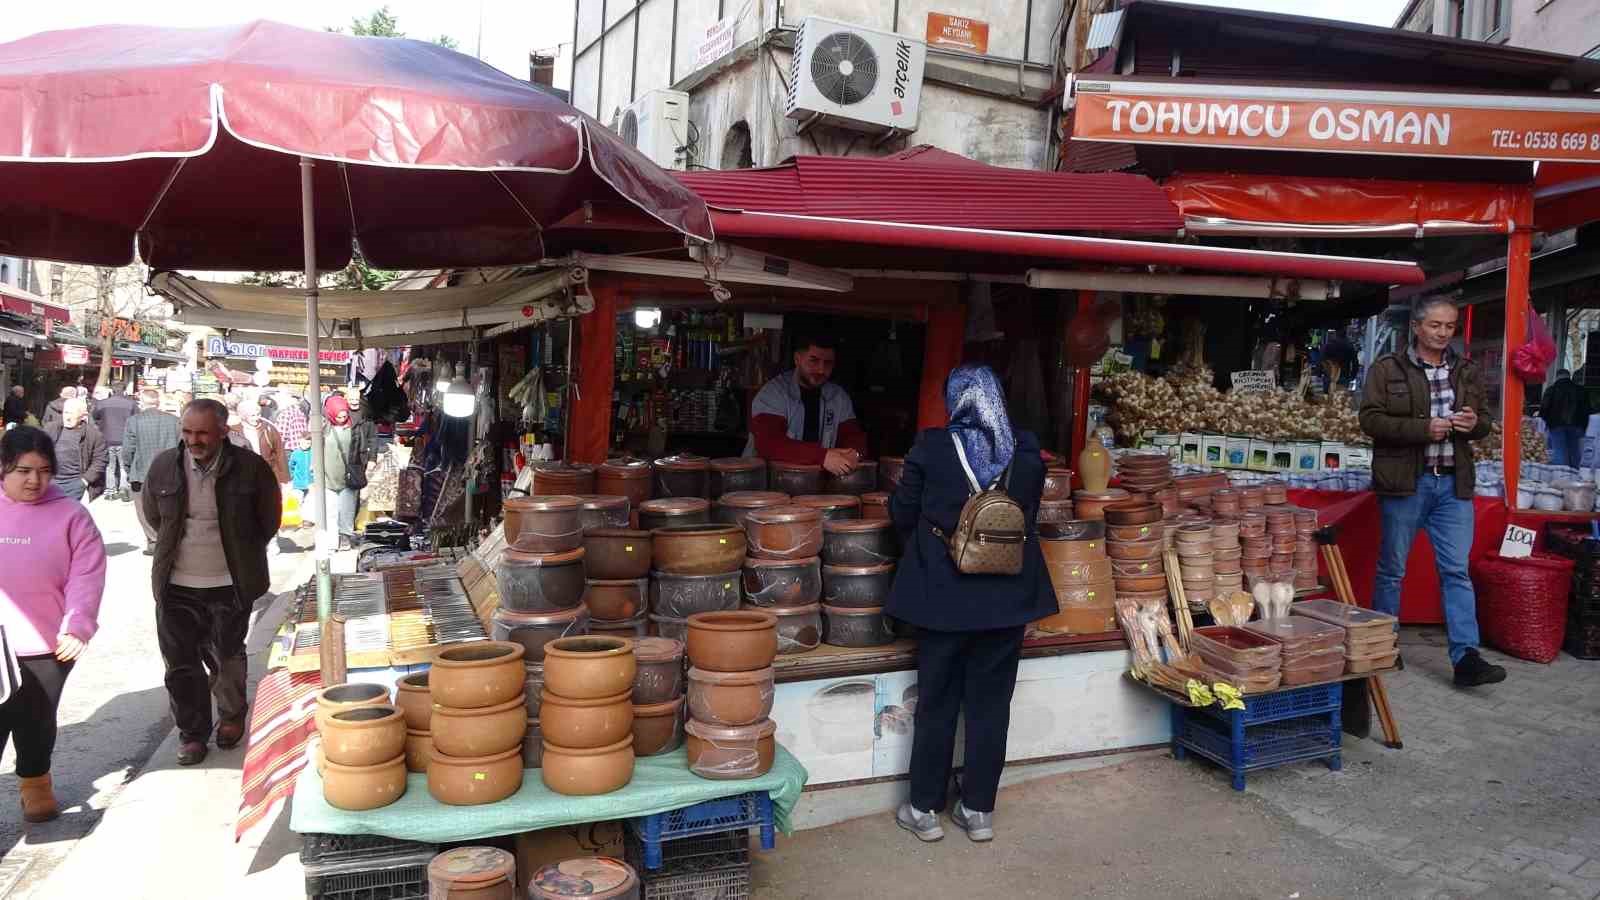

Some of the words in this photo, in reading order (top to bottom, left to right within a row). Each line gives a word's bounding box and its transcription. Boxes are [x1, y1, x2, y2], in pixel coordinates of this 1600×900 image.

[893, 40, 911, 99] arçelik
[1106, 101, 1290, 138] TOHUMCU
[1308, 107, 1451, 146] OSMAN
[1491, 129, 1520, 148] TEL:
[1524, 131, 1558, 149] 0538
[1561, 132, 1587, 151] 669
[1590, 133, 1600, 151] 8
[1505, 526, 1533, 545] 100
